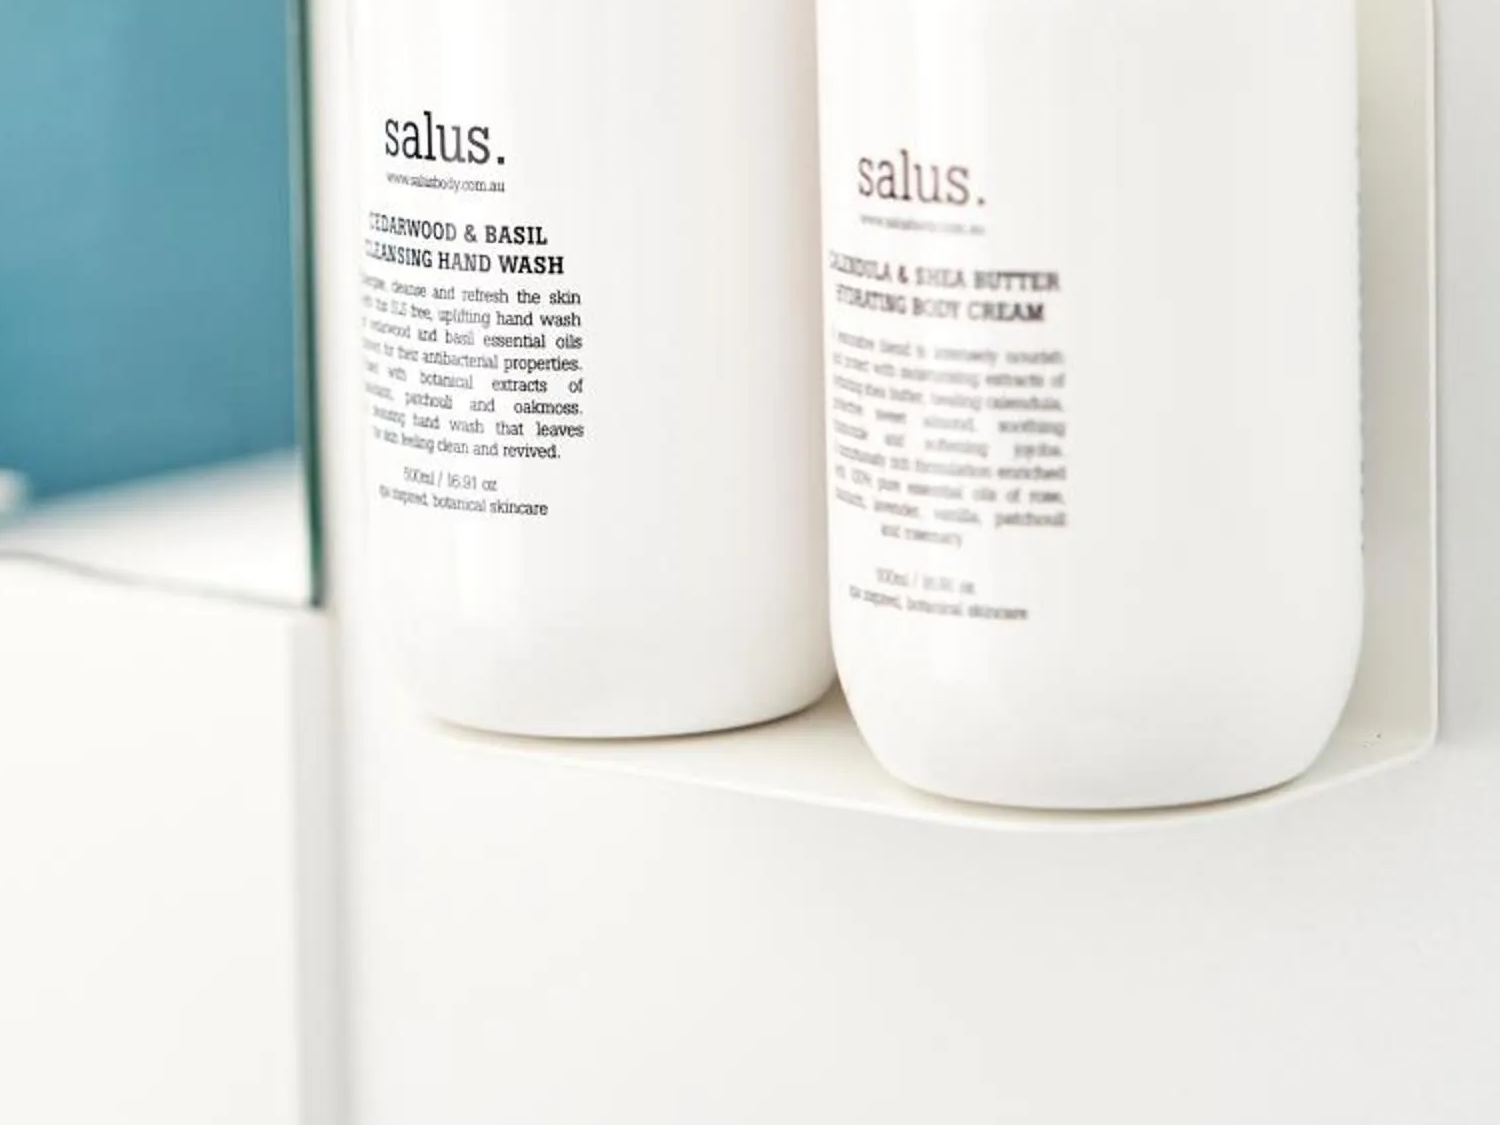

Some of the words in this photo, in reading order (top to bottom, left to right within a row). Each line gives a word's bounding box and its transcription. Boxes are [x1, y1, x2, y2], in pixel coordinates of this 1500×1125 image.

[384, 110, 505, 165] salus.
[858, 148, 985, 206] salus.
[464, 224, 477, 242] &
[485, 225, 548, 245] BASIL
[438, 251, 491, 273] HAND
[498, 255, 565, 274] WASH
[915, 265, 966, 289] SHEA
[974, 270, 1060, 292] BUTTER
[432, 287, 455, 300] and
[462, 288, 509, 304] refresh
[517, 290, 540, 304] the
[549, 290, 581, 305] skin
[438, 309, 491, 329] uplifting
[496, 311, 533, 326] hand
[540, 313, 581, 327] wash
[912, 296, 961, 318] BODY
[967, 300, 1045, 322] CREAM
[445, 329, 474, 345] basil
[483, 333, 545, 349] essential
[555, 334, 583, 349] oils
[422, 348, 498, 369] antibacterial
[504, 356, 583, 374] properties.
[420, 369, 474, 390] botanical
[492, 376, 547, 393] extracts
[568, 378, 584, 394] of
[470, 397, 495, 413] and
[513, 400, 583, 416] oakmoss.
[450, 418, 484, 434] wash
[495, 421, 524, 436] that
[536, 421, 584, 437] leaves
[437, 437, 468, 454] clean
[473, 440, 498, 456] and
[503, 443, 561, 458] revived.
[447, 472, 477, 490] 16.91
[432, 492, 486, 513] botanical
[490, 498, 549, 516] skincare
